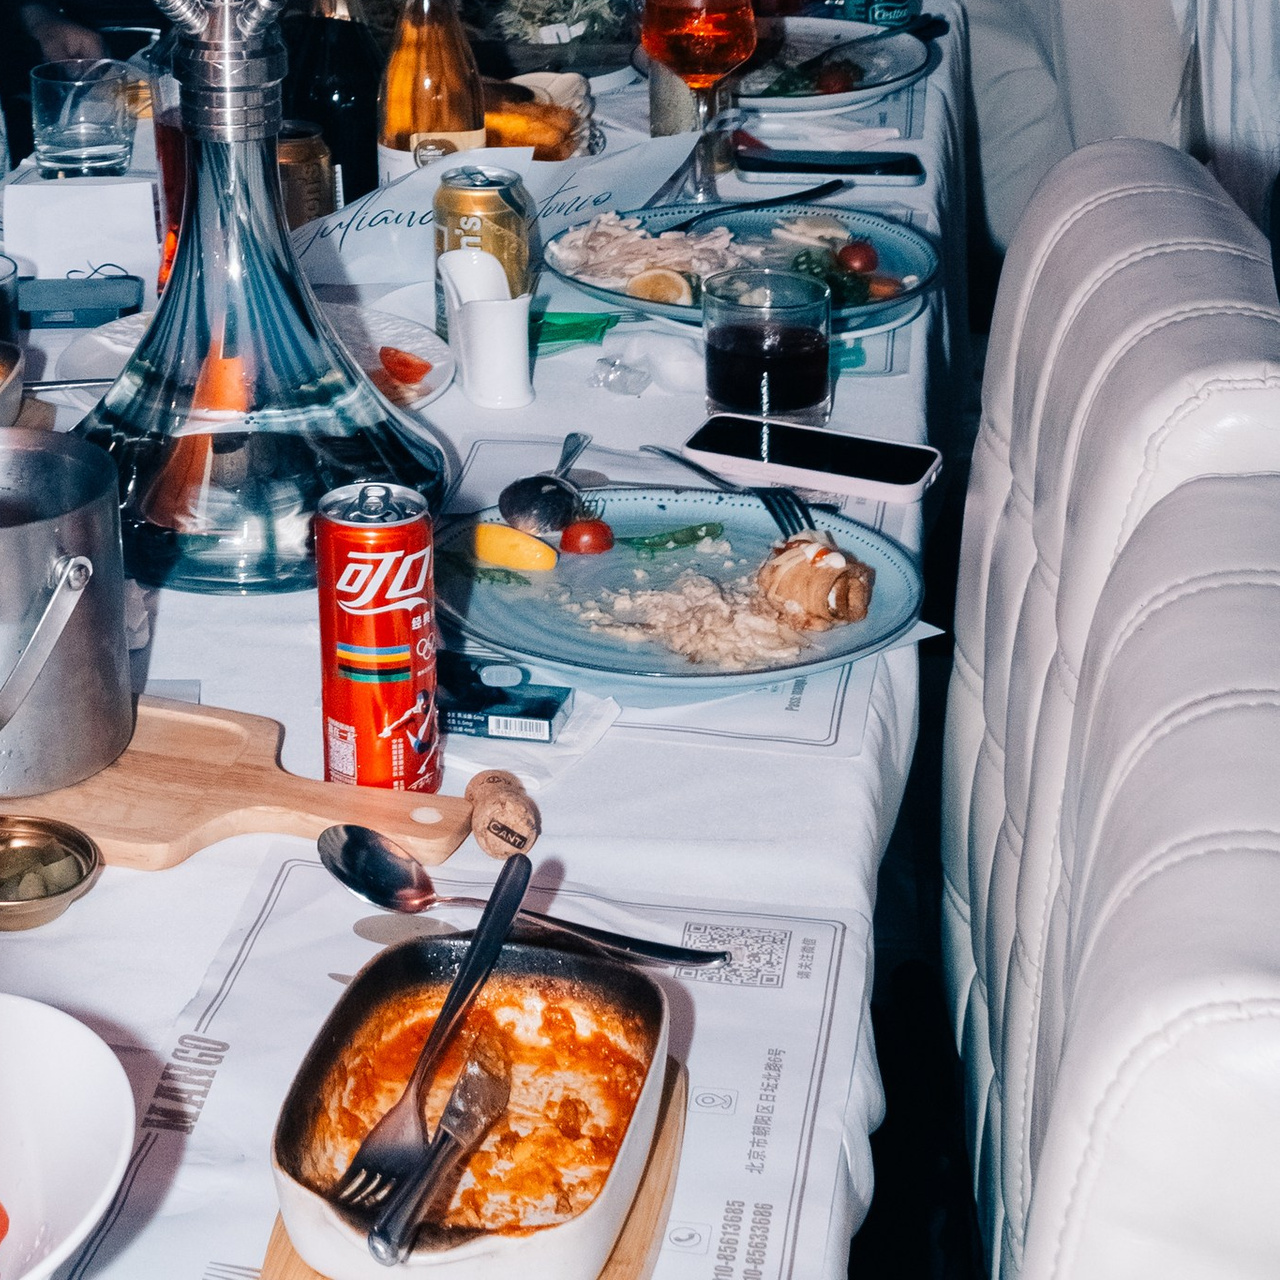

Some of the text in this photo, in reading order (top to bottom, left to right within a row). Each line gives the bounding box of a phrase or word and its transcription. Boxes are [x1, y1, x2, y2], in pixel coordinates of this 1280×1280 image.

[335, 544, 432, 613] 可口
[489, 820, 526, 849] CANTI
[140, 1033, 231, 1135] MANGO
